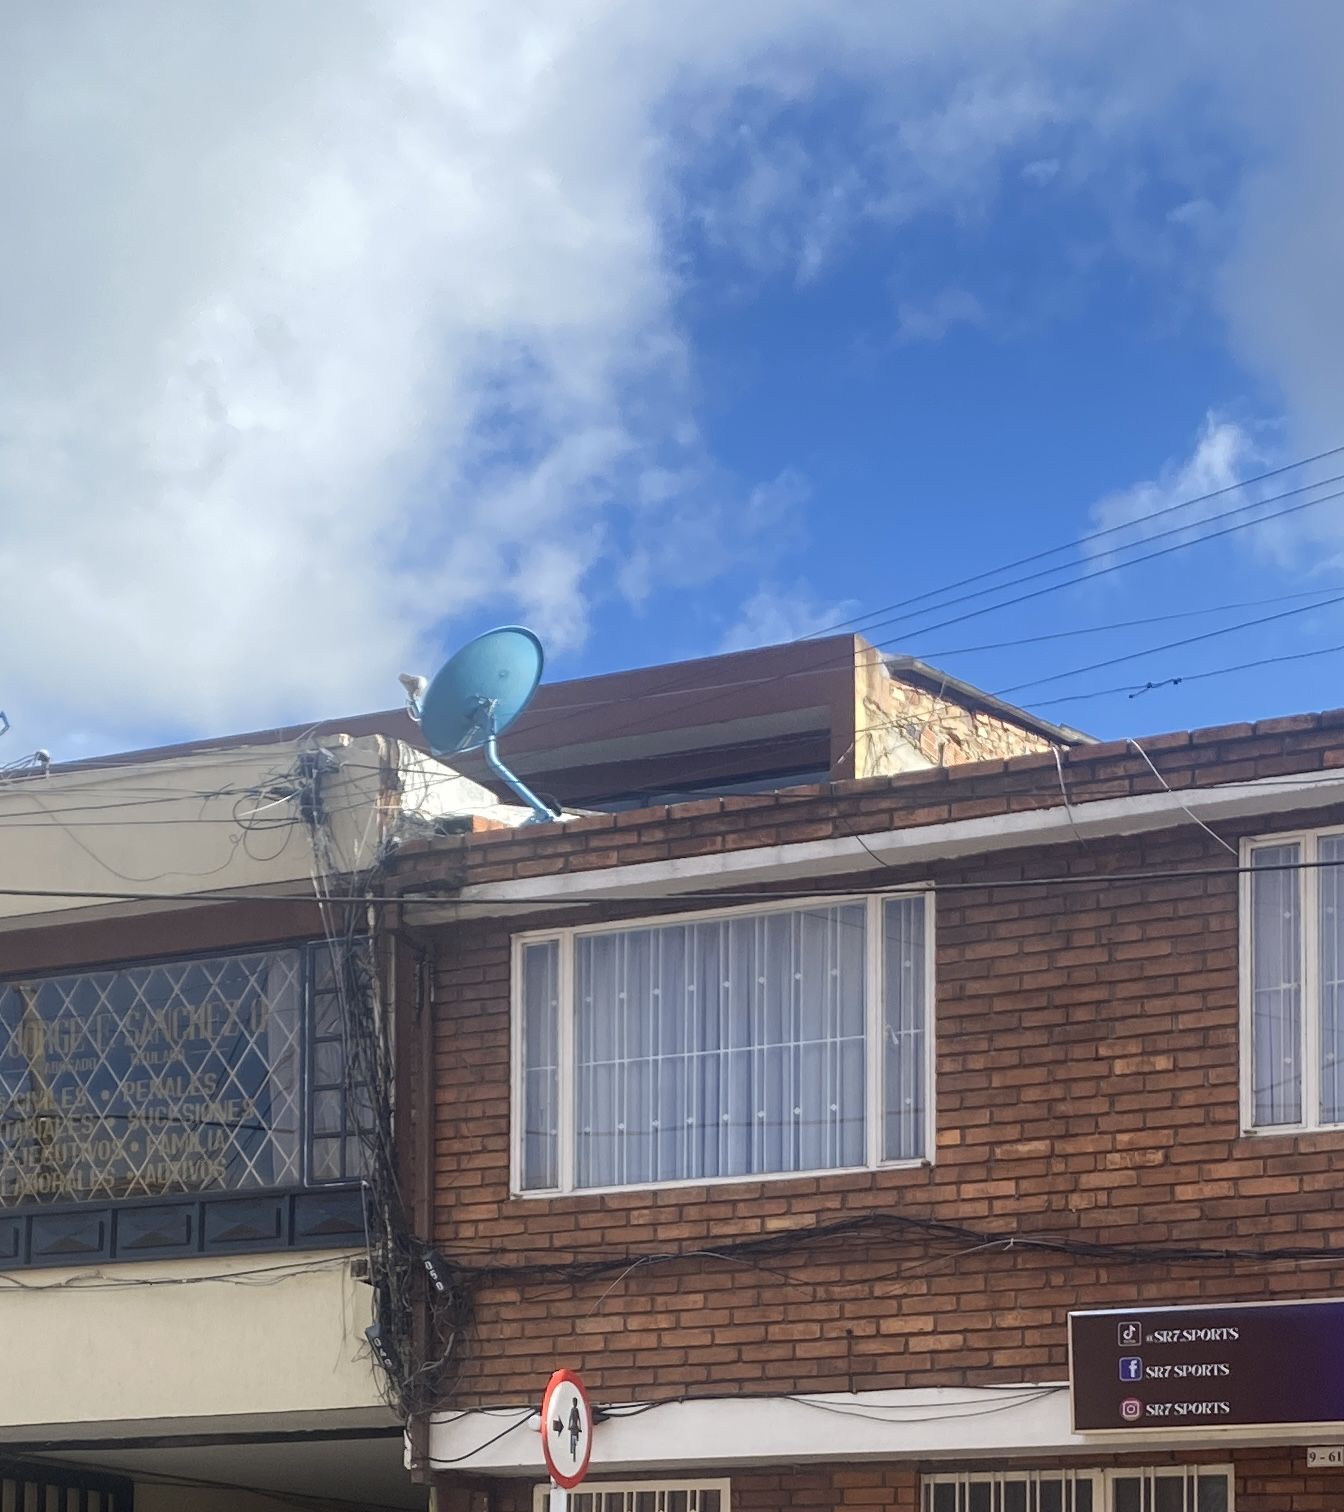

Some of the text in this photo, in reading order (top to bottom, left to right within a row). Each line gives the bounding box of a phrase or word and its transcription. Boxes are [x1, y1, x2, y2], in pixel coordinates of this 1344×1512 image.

[1146, 1363, 1230, 1378] SR7 SPORTS
[1146, 1402, 1230, 1416] SR7 SPORTS
